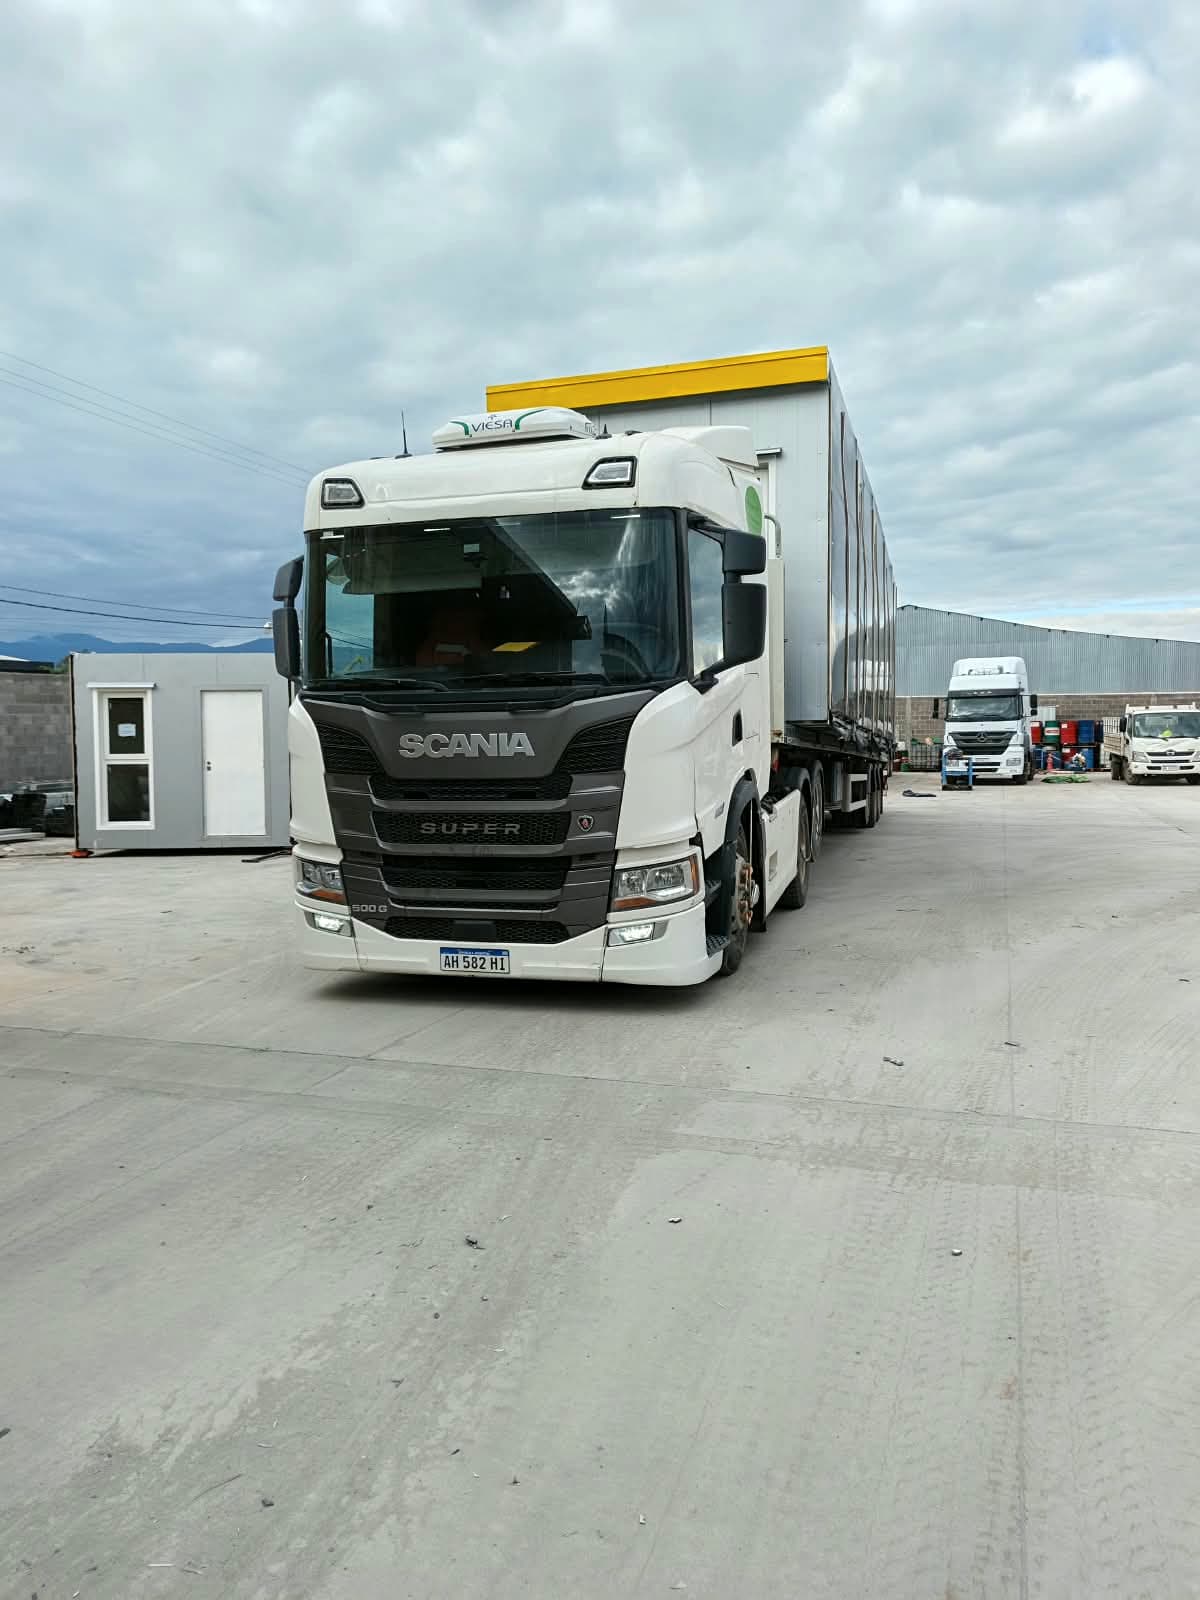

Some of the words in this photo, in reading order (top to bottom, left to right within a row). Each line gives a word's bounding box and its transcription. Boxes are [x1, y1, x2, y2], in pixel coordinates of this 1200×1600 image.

[471, 419, 513, 432] VIESA
[399, 732, 536, 758] SCANIA
[420, 822, 521, 835] SUPER
[378, 905, 388, 913] G
[444, 955, 459, 969] AH
[463, 956, 487, 970] 582
[490, 957, 505, 971] HI
